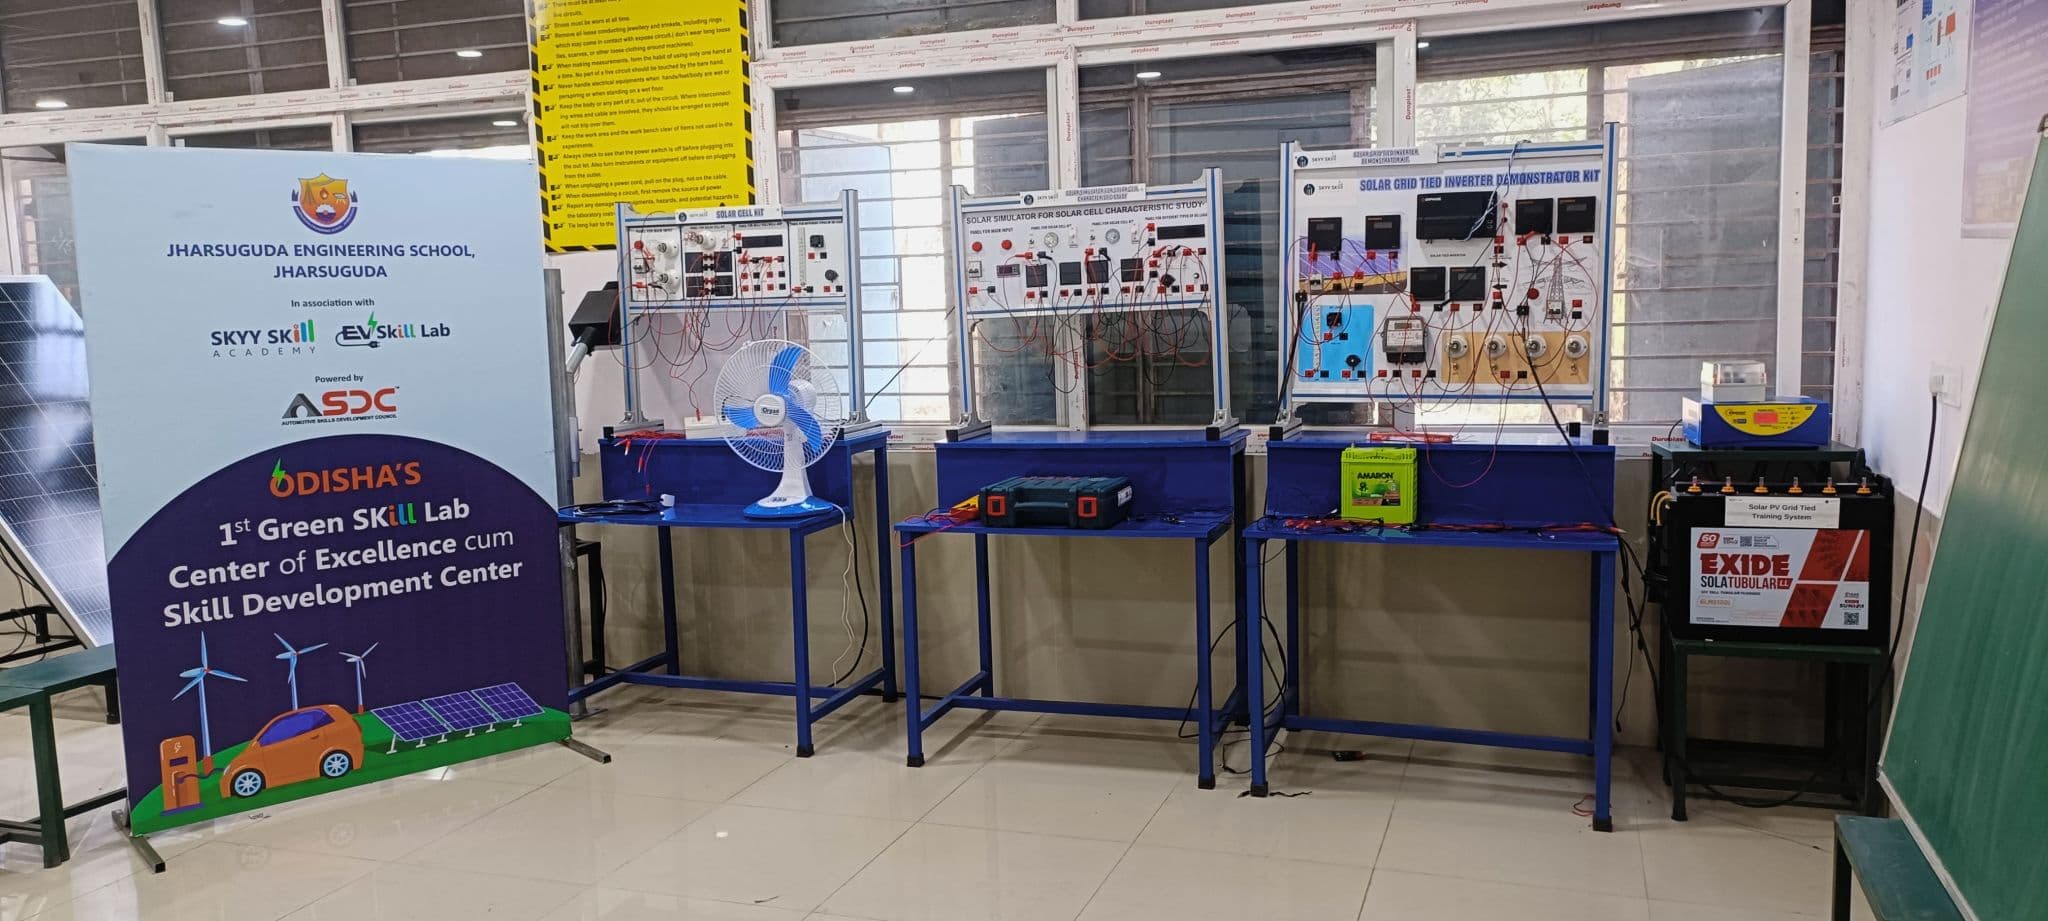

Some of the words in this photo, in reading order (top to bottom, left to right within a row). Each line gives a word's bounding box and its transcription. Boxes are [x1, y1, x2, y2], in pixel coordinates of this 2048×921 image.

[1360, 178, 1392, 191] SOLAR
[1394, 177, 1417, 190] GRID
[1419, 176, 1442, 189] TIED
[1444, 174, 1494, 187] INVERTER
[1496, 171, 1580, 186] DEMONSTRATOR
[1583, 169, 1601, 182] KIT
[716, 210, 736, 219] SOLAR
[737, 209, 753, 218] CELL
[754, 208, 765, 217] KIT
[966, 215, 991, 224] SOLAR
[993, 213, 1036, 223] SIMULATOR
[1038, 211, 1054, 220] FOR
[1055, 209, 1082, 218] SOLAR
[1083, 208, 1104, 216] CELL
[1105, 204, 1174, 214] CHARACTERISTIC
[1175, 200, 1203, 209] STUDY
[167, 244, 289, 258] JHARSUGUDA
[294, 244, 405, 258] ENGINEERING
[410, 245, 476, 259] SCHOOL,
[274, 265, 387, 278] JHARSUGUDA
[291, 300, 300, 308] In
[302, 299, 352, 307] association
[354, 298, 375, 307] with
[211, 330, 261, 346] SKYY
[377, 323, 416, 339] Skill
[421, 323, 450, 338] Lab
[315, 374, 351, 384] Powered
[353, 373, 364, 383] by
[336, 415, 374, 423] DEVELOPMENT
[219, 517, 251, 547] 1st
[258, 517, 344, 542] Green
[424, 497, 470, 523] Lab
[1701, 534, 1717, 542] 60
[168, 558, 270, 590] Center
[279, 549, 307, 575] of
[316, 537, 457, 571] Excellence
[464, 530, 514, 551] cum
[1700, 553, 1790, 576] EXIDE
[1701, 576, 1777, 589] SOLATUBULAR
[164, 595, 233, 628] Skill
[242, 571, 433, 617] Development
[439, 560, 523, 588] Center
